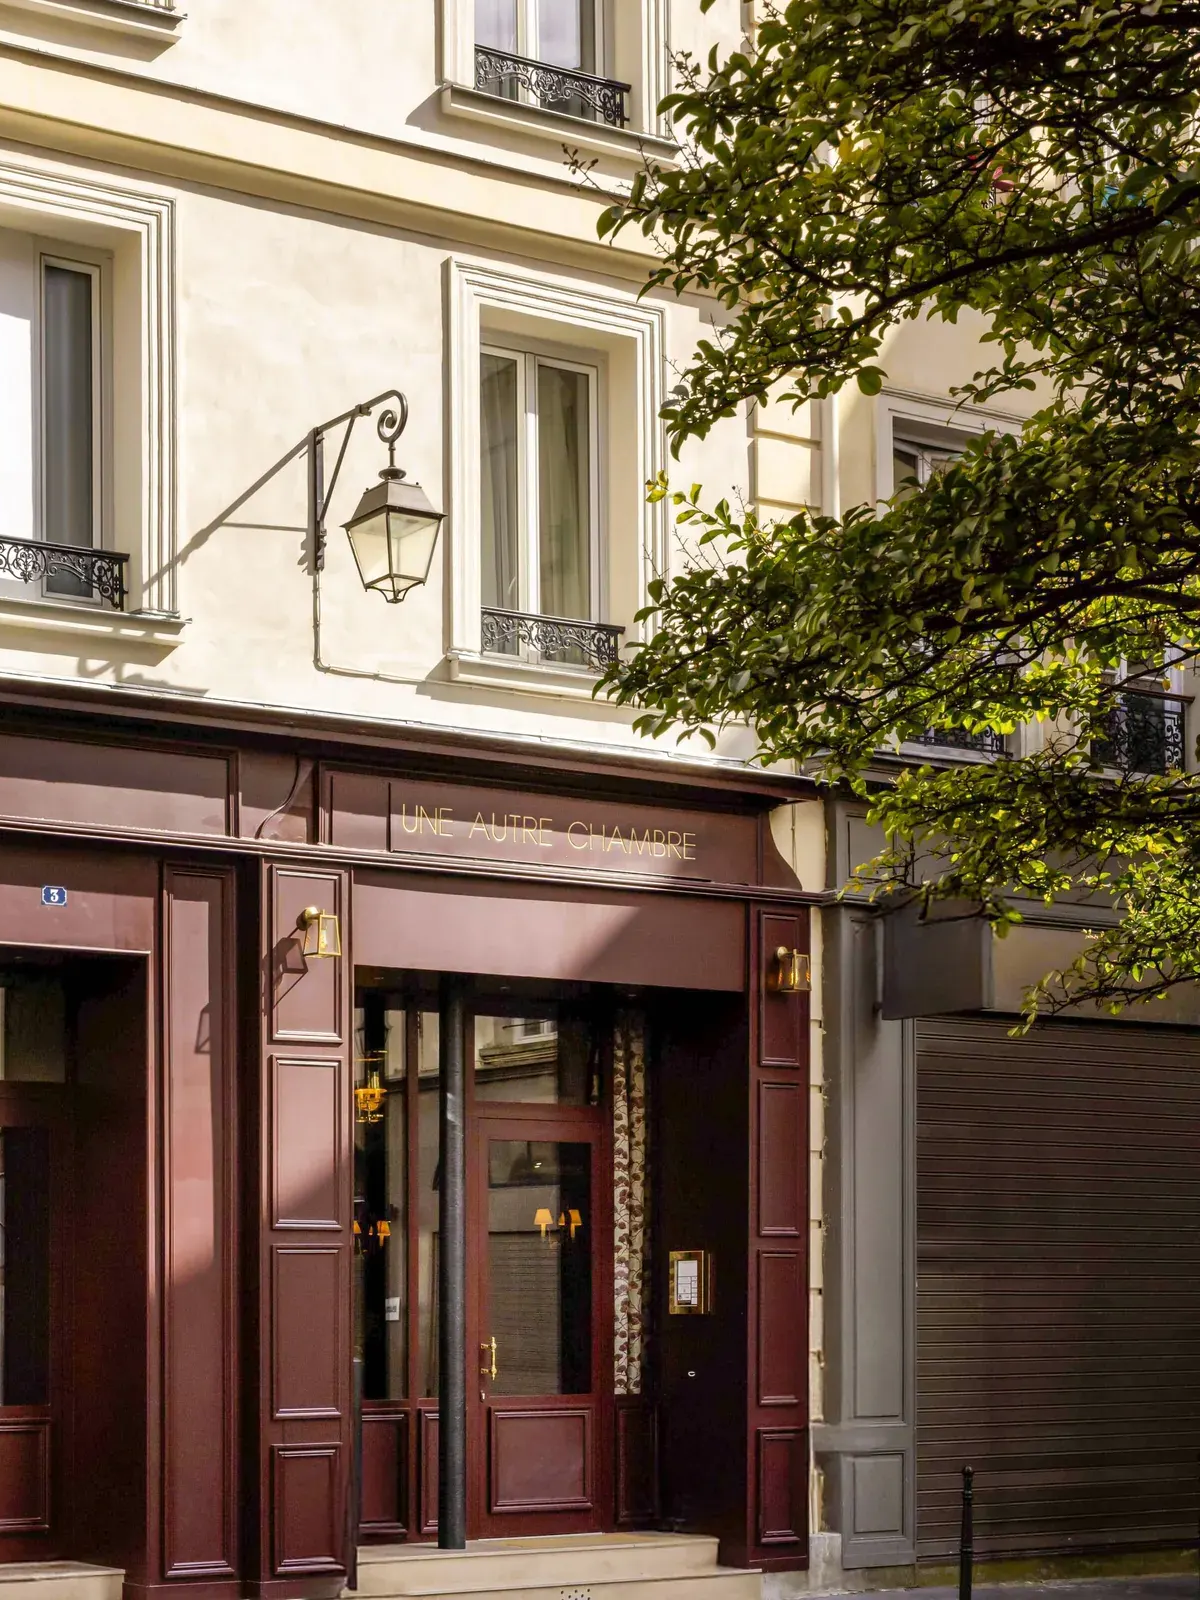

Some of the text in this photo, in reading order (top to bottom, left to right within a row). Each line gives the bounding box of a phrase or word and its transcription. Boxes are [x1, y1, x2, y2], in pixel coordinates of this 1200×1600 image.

[401, 803, 697, 861] UNE AUTRE CHAMBRE
[50, 888, 59, 903] 3
